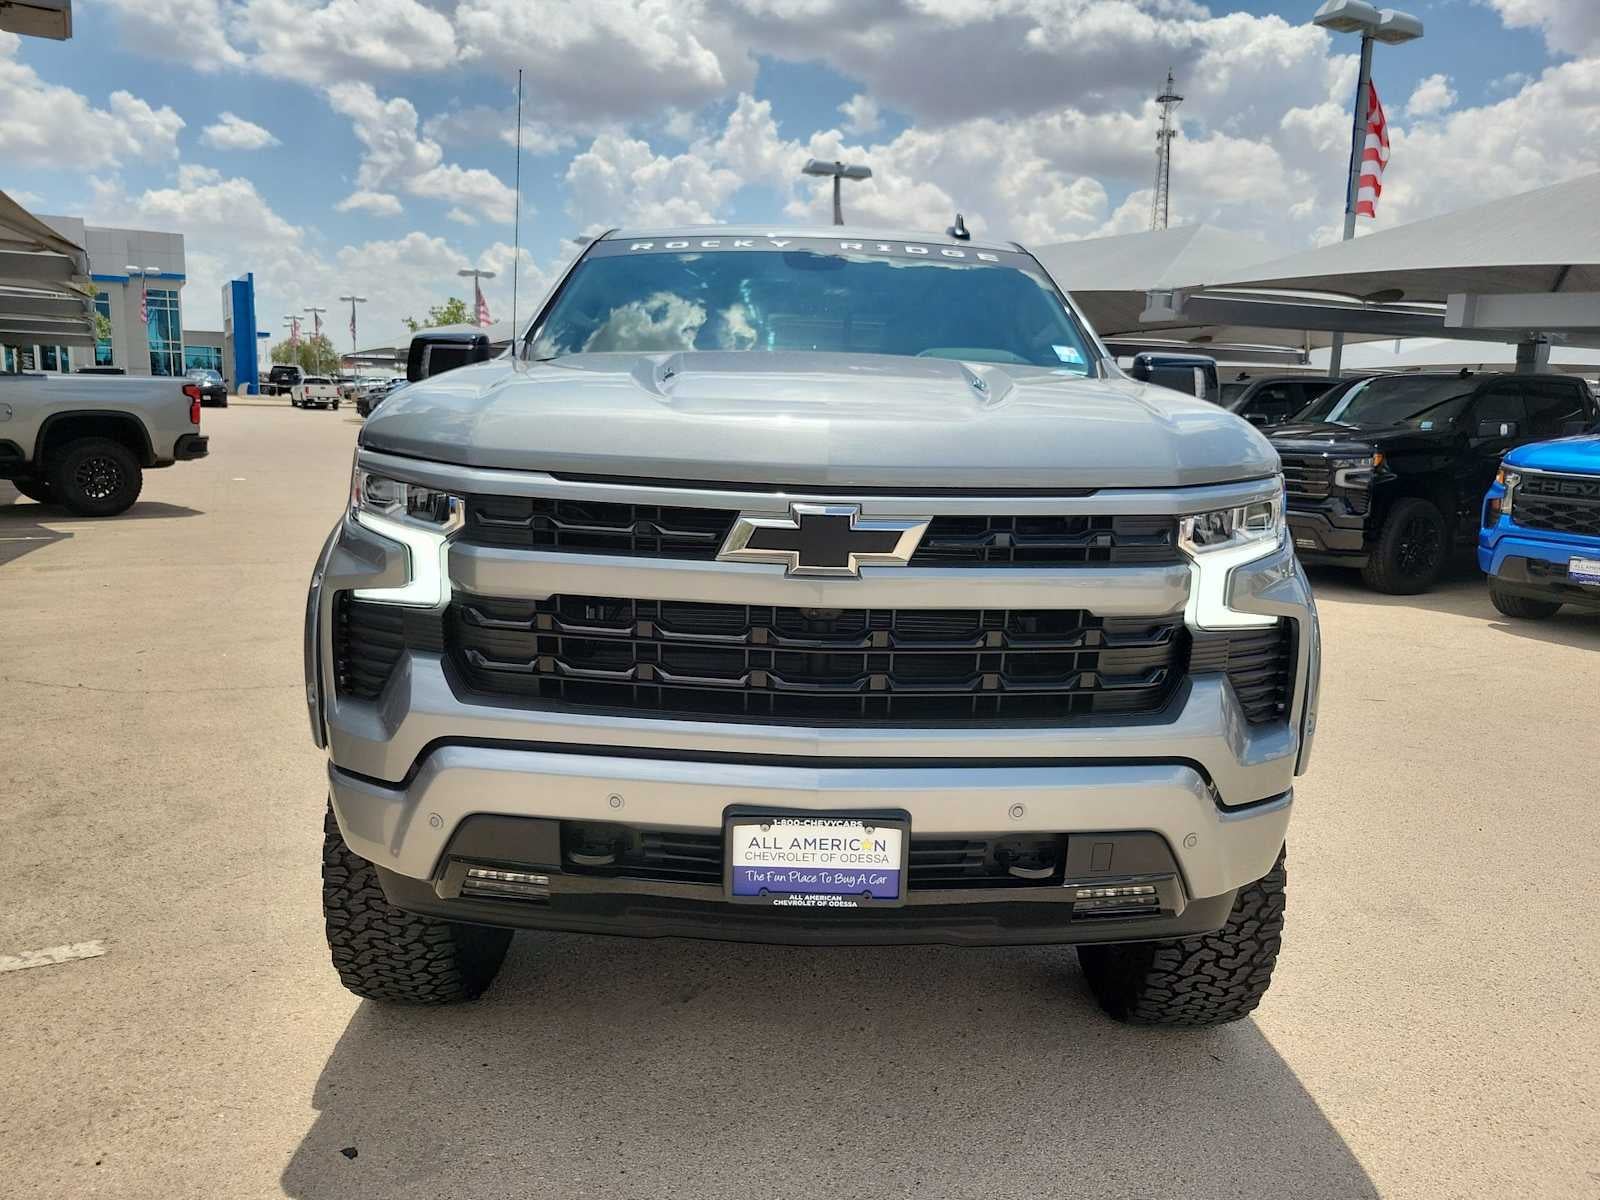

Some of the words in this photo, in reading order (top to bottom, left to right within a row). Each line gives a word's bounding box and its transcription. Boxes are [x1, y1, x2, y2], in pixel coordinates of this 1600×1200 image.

[630, 239, 792, 251] ROCKY
[840, 242, 1000, 262] RIDGE
[773, 818, 864, 828] 1-800-CHEVYCARS
[748, 836, 783, 850] ALL
[789, 837, 886, 852] AMERICN
[744, 851, 816, 862] CHEVROLET
[820, 852, 836, 863] OF
[840, 853, 889, 864] ODESSA
[745, 870, 765, 882] The
[767, 871, 786, 882] Fun
[788, 871, 817, 883] Place
[819, 871, 832, 884] To
[834, 873, 856, 888] Buy
[857, 874, 867, 885] A
[869, 873, 888, 885] Car
